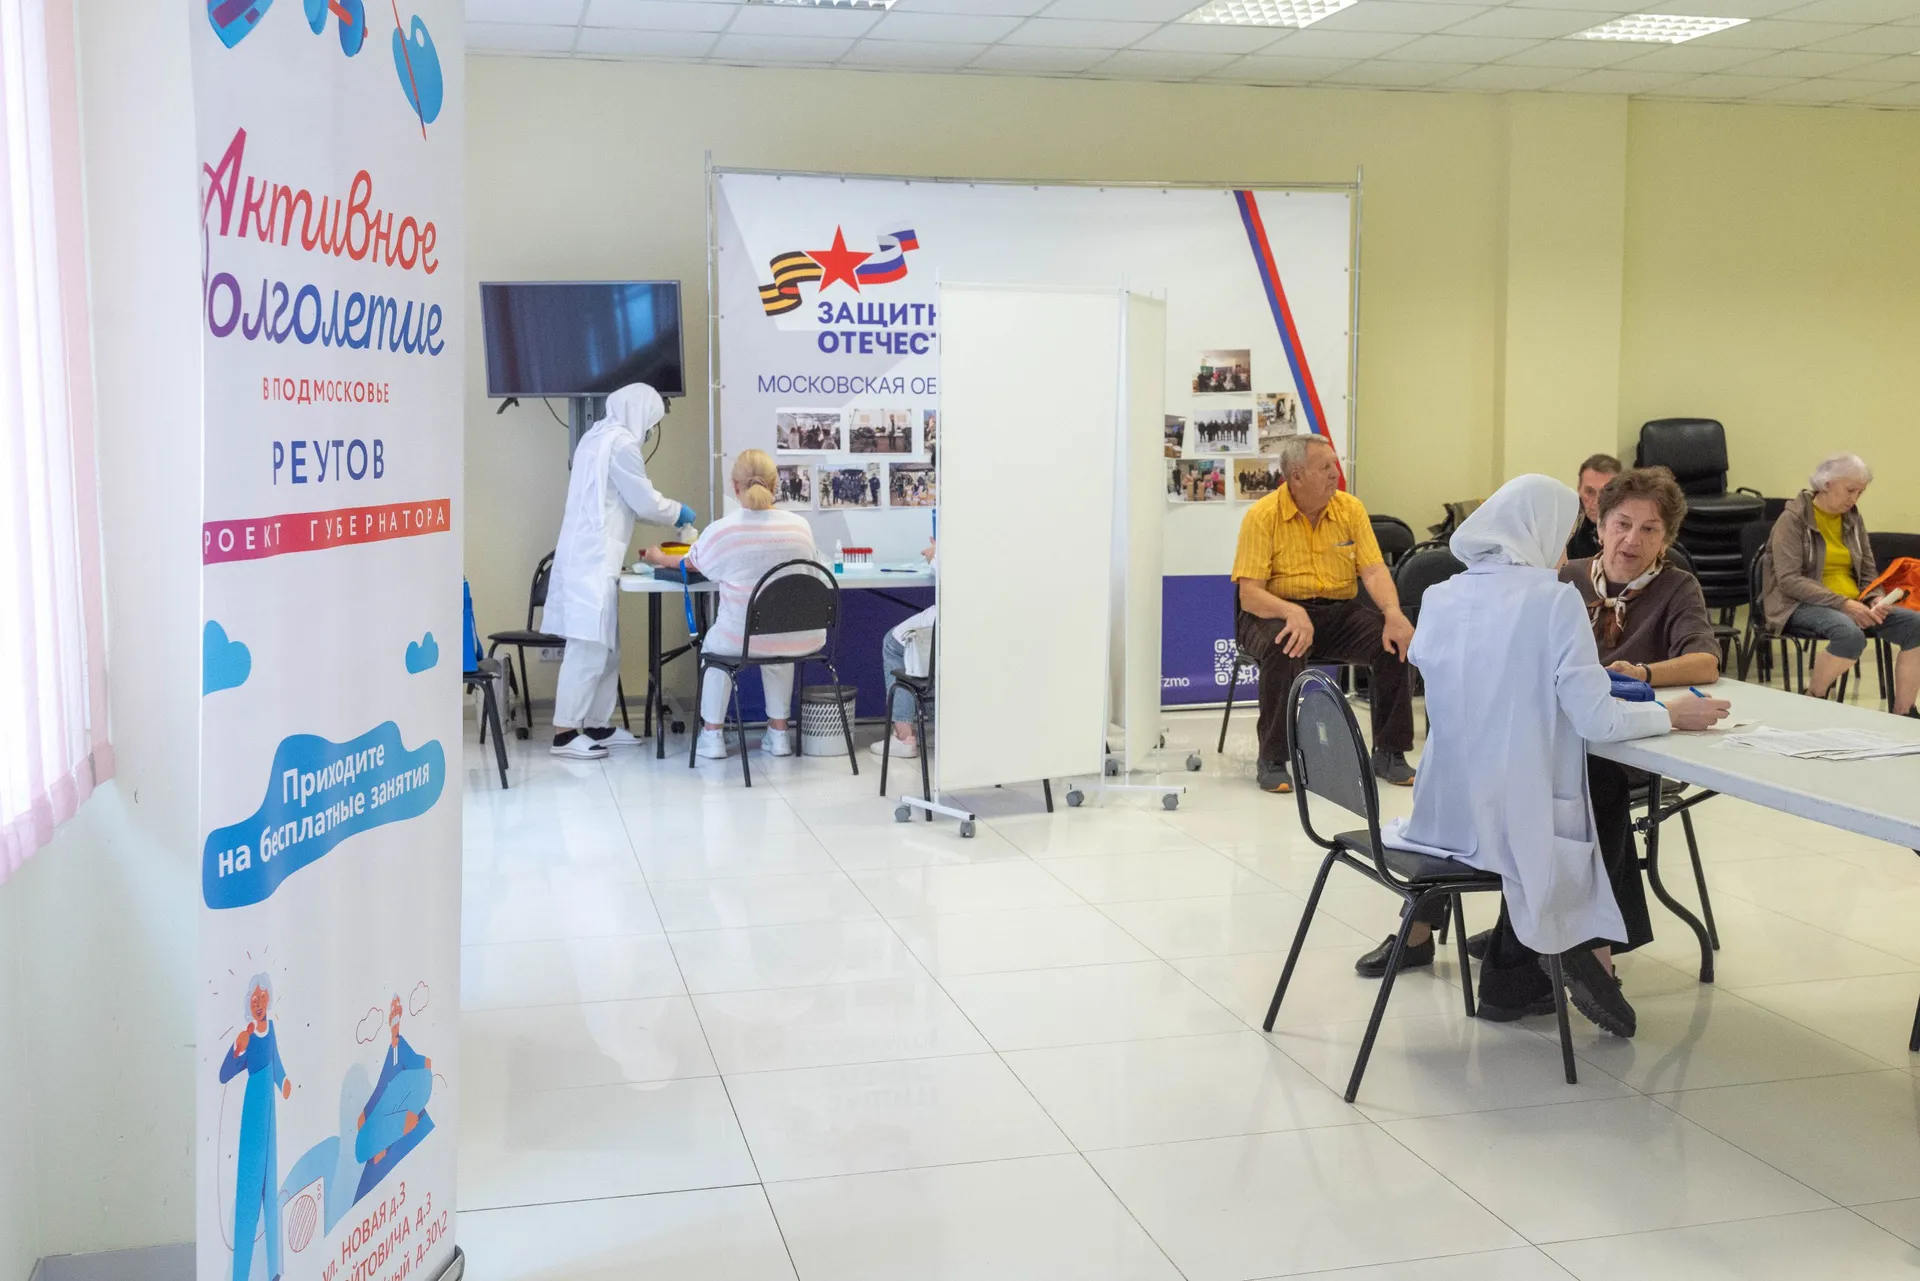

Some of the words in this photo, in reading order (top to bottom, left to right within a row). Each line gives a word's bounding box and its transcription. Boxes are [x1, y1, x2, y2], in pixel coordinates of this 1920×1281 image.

[202, 126, 439, 274] Активное
[262, 377, 270, 400] В
[273, 378, 389, 404] ПОДМОСКОВЬЕ
[758, 375, 904, 394] МОСКОВСКАЯ
[273, 438, 384, 485] РЕУТОВ
[310, 506, 445, 541] ГУБЕРНАТОРА
[1160, 674, 1190, 688] zmo
[282, 743, 385, 808] Приходите
[218, 843, 251, 878] на
[260, 791, 364, 863] бесплатные
[370, 762, 430, 809] занятия
[342, 1200, 387, 1265] НОВАЯ
[389, 1181, 406, 1222] д.3
[345, 1216, 411, 1281] ЙТОВИЧА
[415, 1191, 431, 1232] д.3
